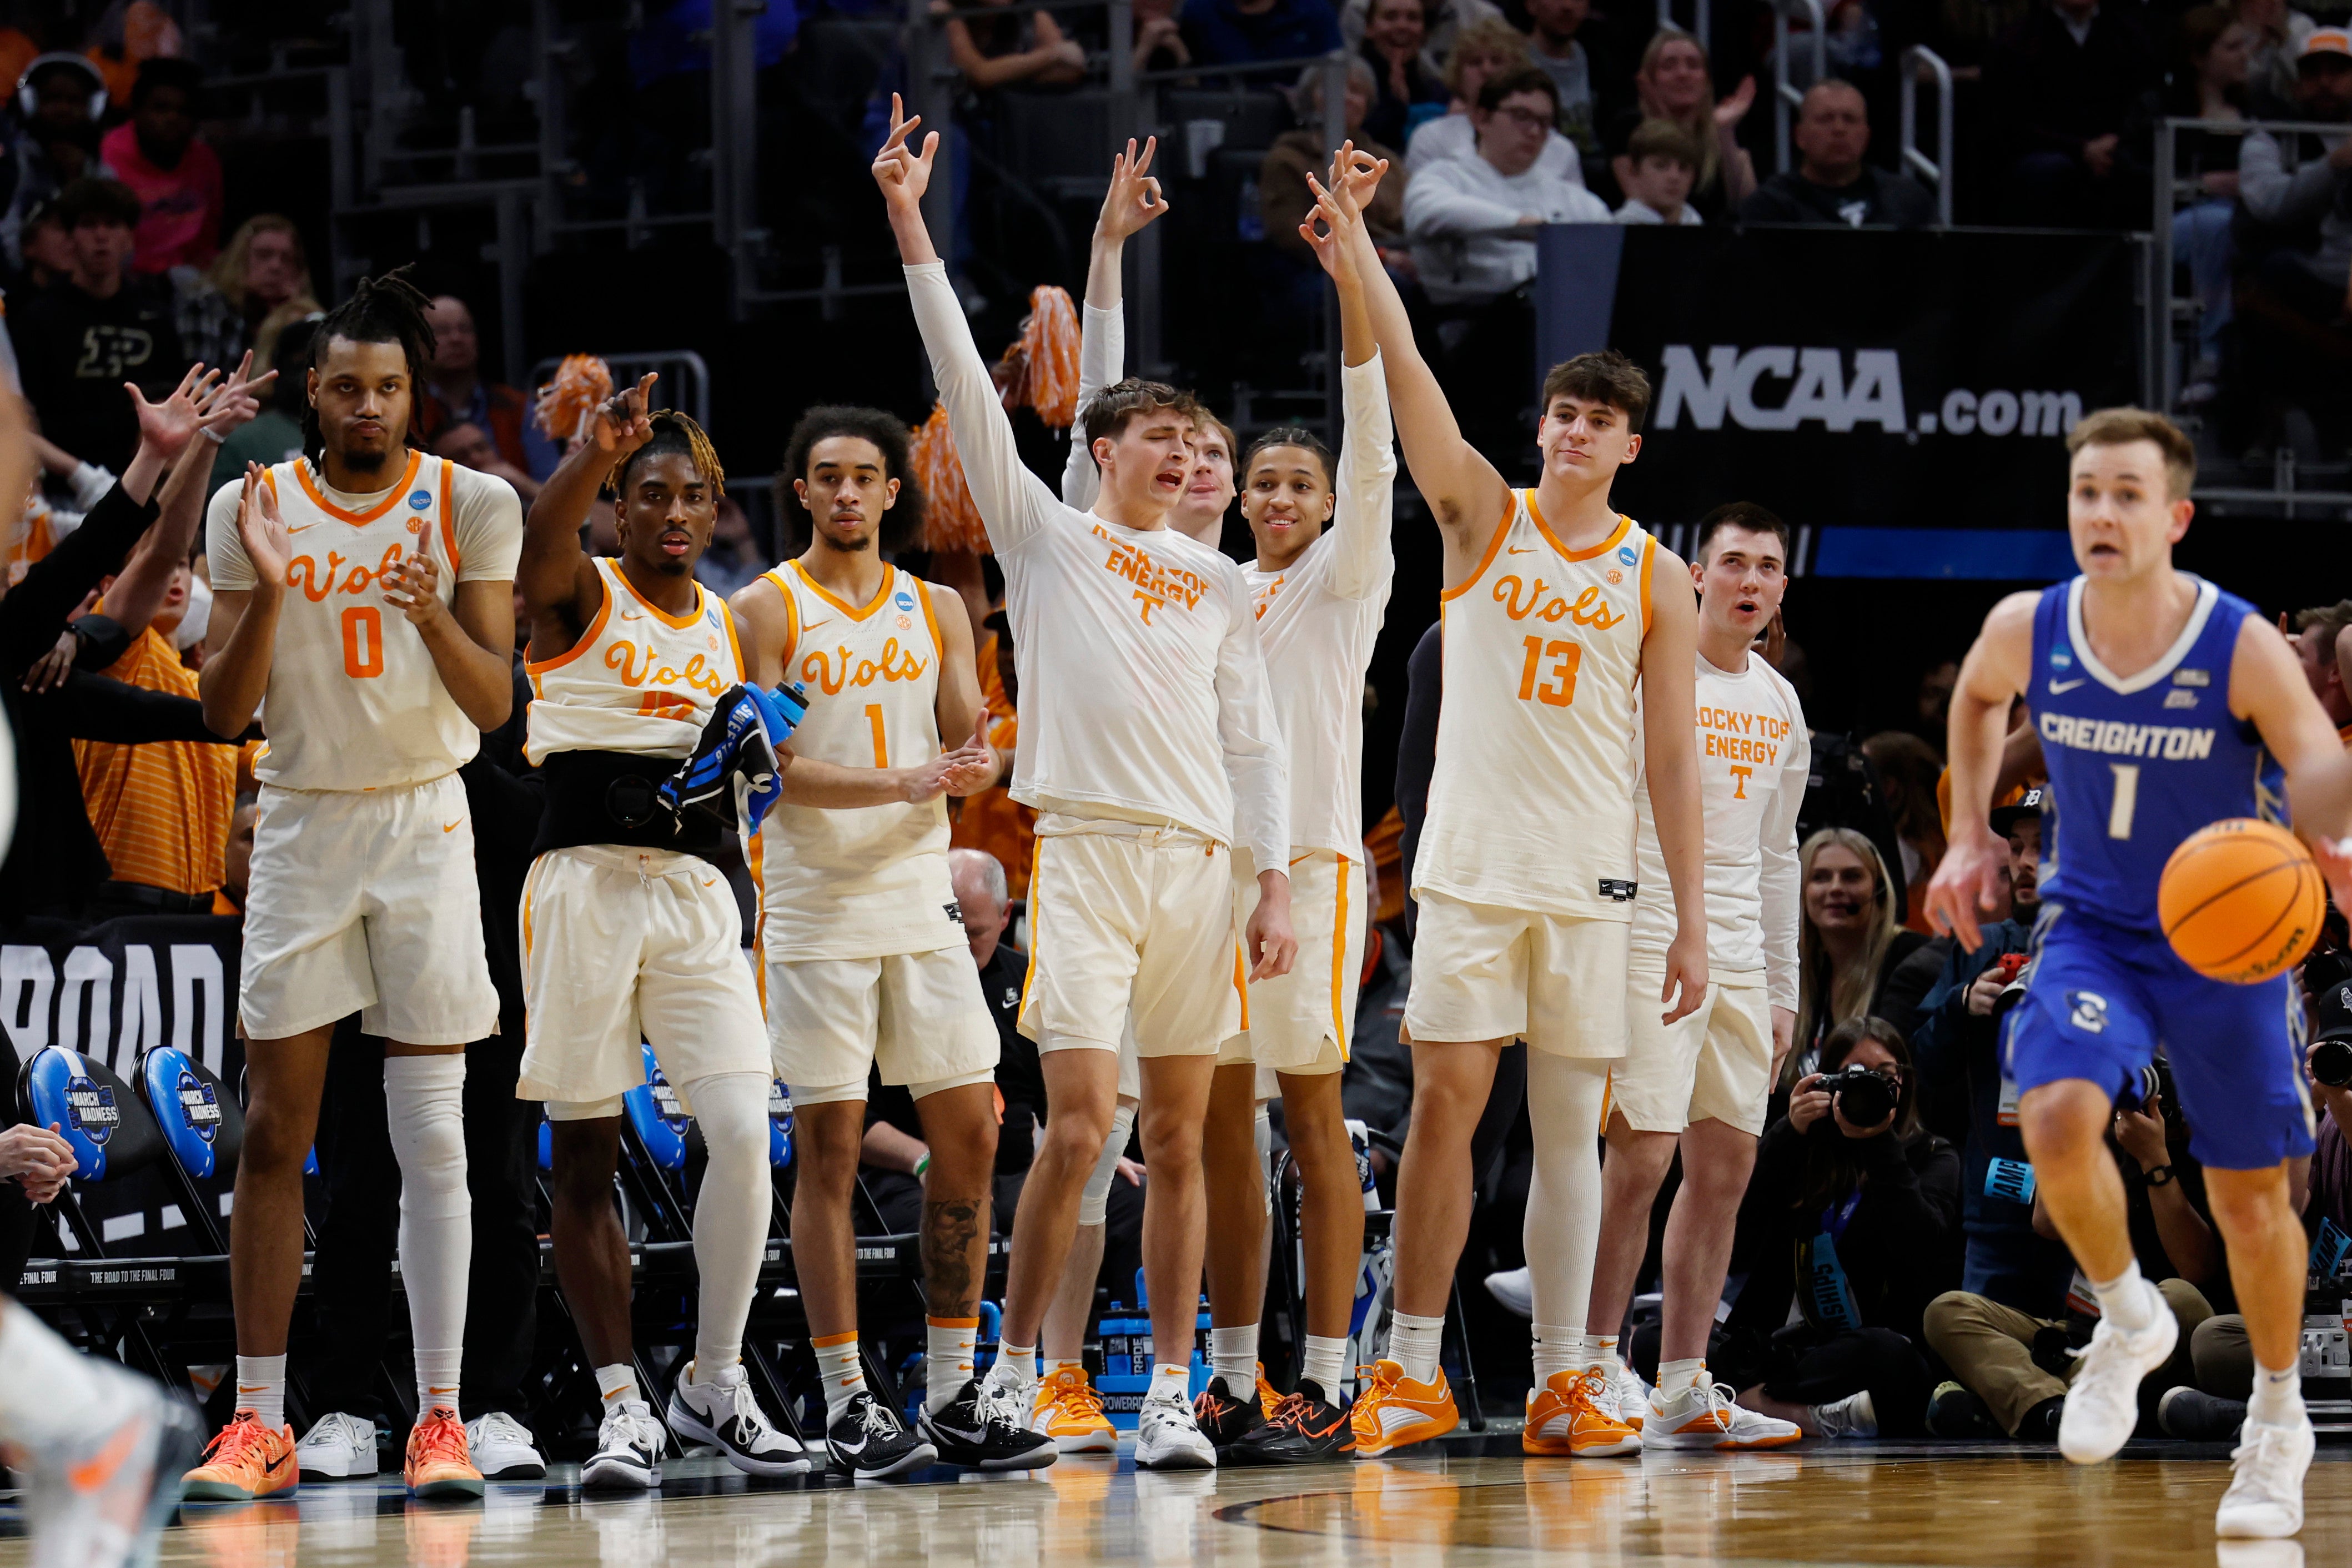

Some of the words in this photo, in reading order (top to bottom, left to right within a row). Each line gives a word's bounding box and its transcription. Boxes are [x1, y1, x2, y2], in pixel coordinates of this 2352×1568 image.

[287, 543, 416, 602] Vol
[1105, 549, 1200, 612] ENERGY
[1133, 589, 1165, 626] T
[1492, 575, 1626, 631] Vols
[341, 606, 384, 679] 0
[605, 640, 730, 697] Vols
[801, 637, 928, 696] Vols
[1518, 635, 1582, 708] 13
[865, 703, 888, 769] 1
[1756, 715, 1789, 742] TOP
[2039, 711, 2216, 761] CREIGHTON
[1705, 733, 1778, 766] ENERGY
[1730, 765, 1752, 800] T
[2108, 762, 2140, 841] 1
[71, 1091, 100, 1107] MARCH
[79, 1106, 118, 1122] MADNESS
[182, 1090, 205, 1105] MARCH
[189, 1103, 220, 1120] MADNESS
[23, 1272, 40, 1285] FINAL
[41, 1270, 57, 1284] FOUR
[90, 1272, 103, 1284] THE
[104, 1271, 120, 1284] ROAD
[120, 1270, 128, 1283] TO
[129, 1270, 140, 1283] THE
[141, 1269, 158, 1282] FINAL
[159, 1269, 175, 1281] FOUR
[1103, 1396, 1145, 1411] POWERAD
